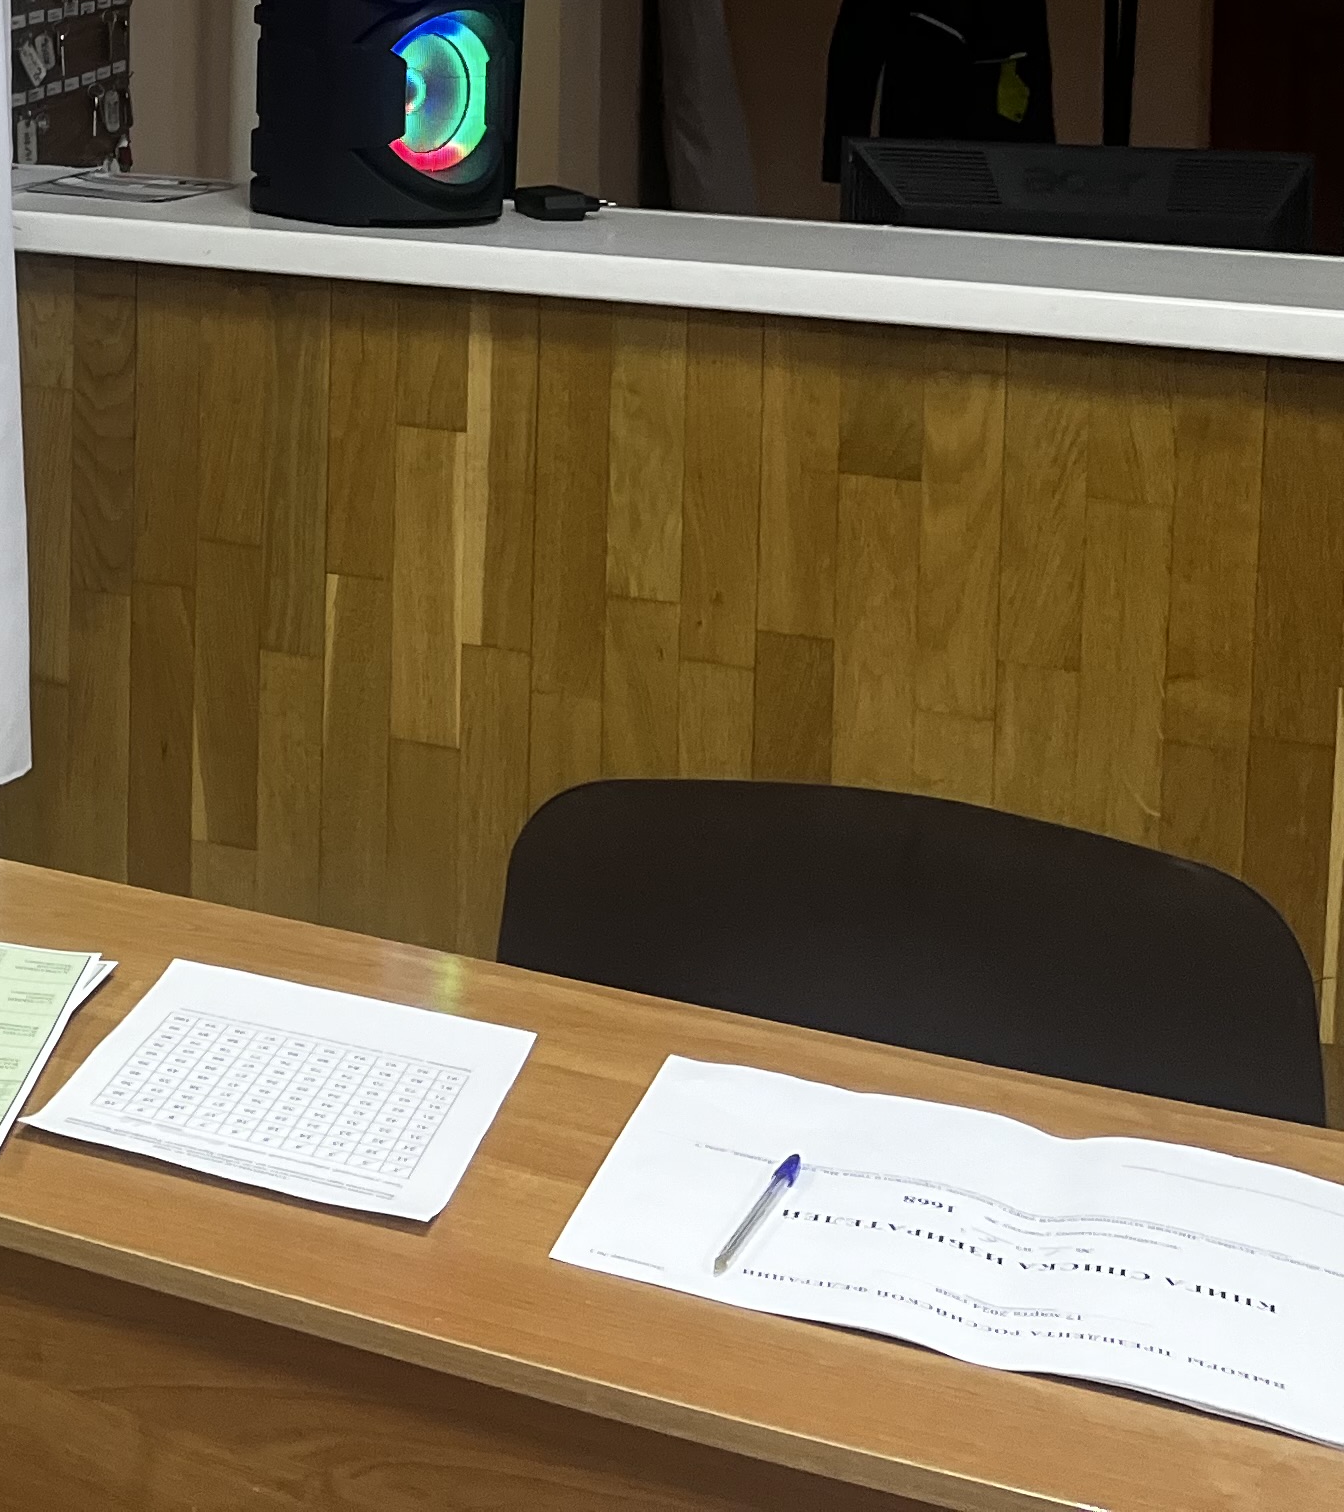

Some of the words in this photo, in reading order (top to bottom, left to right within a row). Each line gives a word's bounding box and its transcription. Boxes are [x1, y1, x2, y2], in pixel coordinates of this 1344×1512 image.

[902, 1195, 955, 1213] 1668
[783, 1209, 1005, 1266] ИЗБИРАТЕЛЕЙ
[743, 1269, 867, 1293] ФЕДЕРАЦИИ
[1019, 1262, 1151, 1281] СПИСКА
[1165, 1277, 1276, 1314] КНИГА
[878, 1291, 1019, 1336] РОССИЙСКОЙ
[1031, 1331, 1171, 1357] ПРЕЗИДЕНТА
[1187, 1357, 1286, 1390] ВЫБОРЫ
